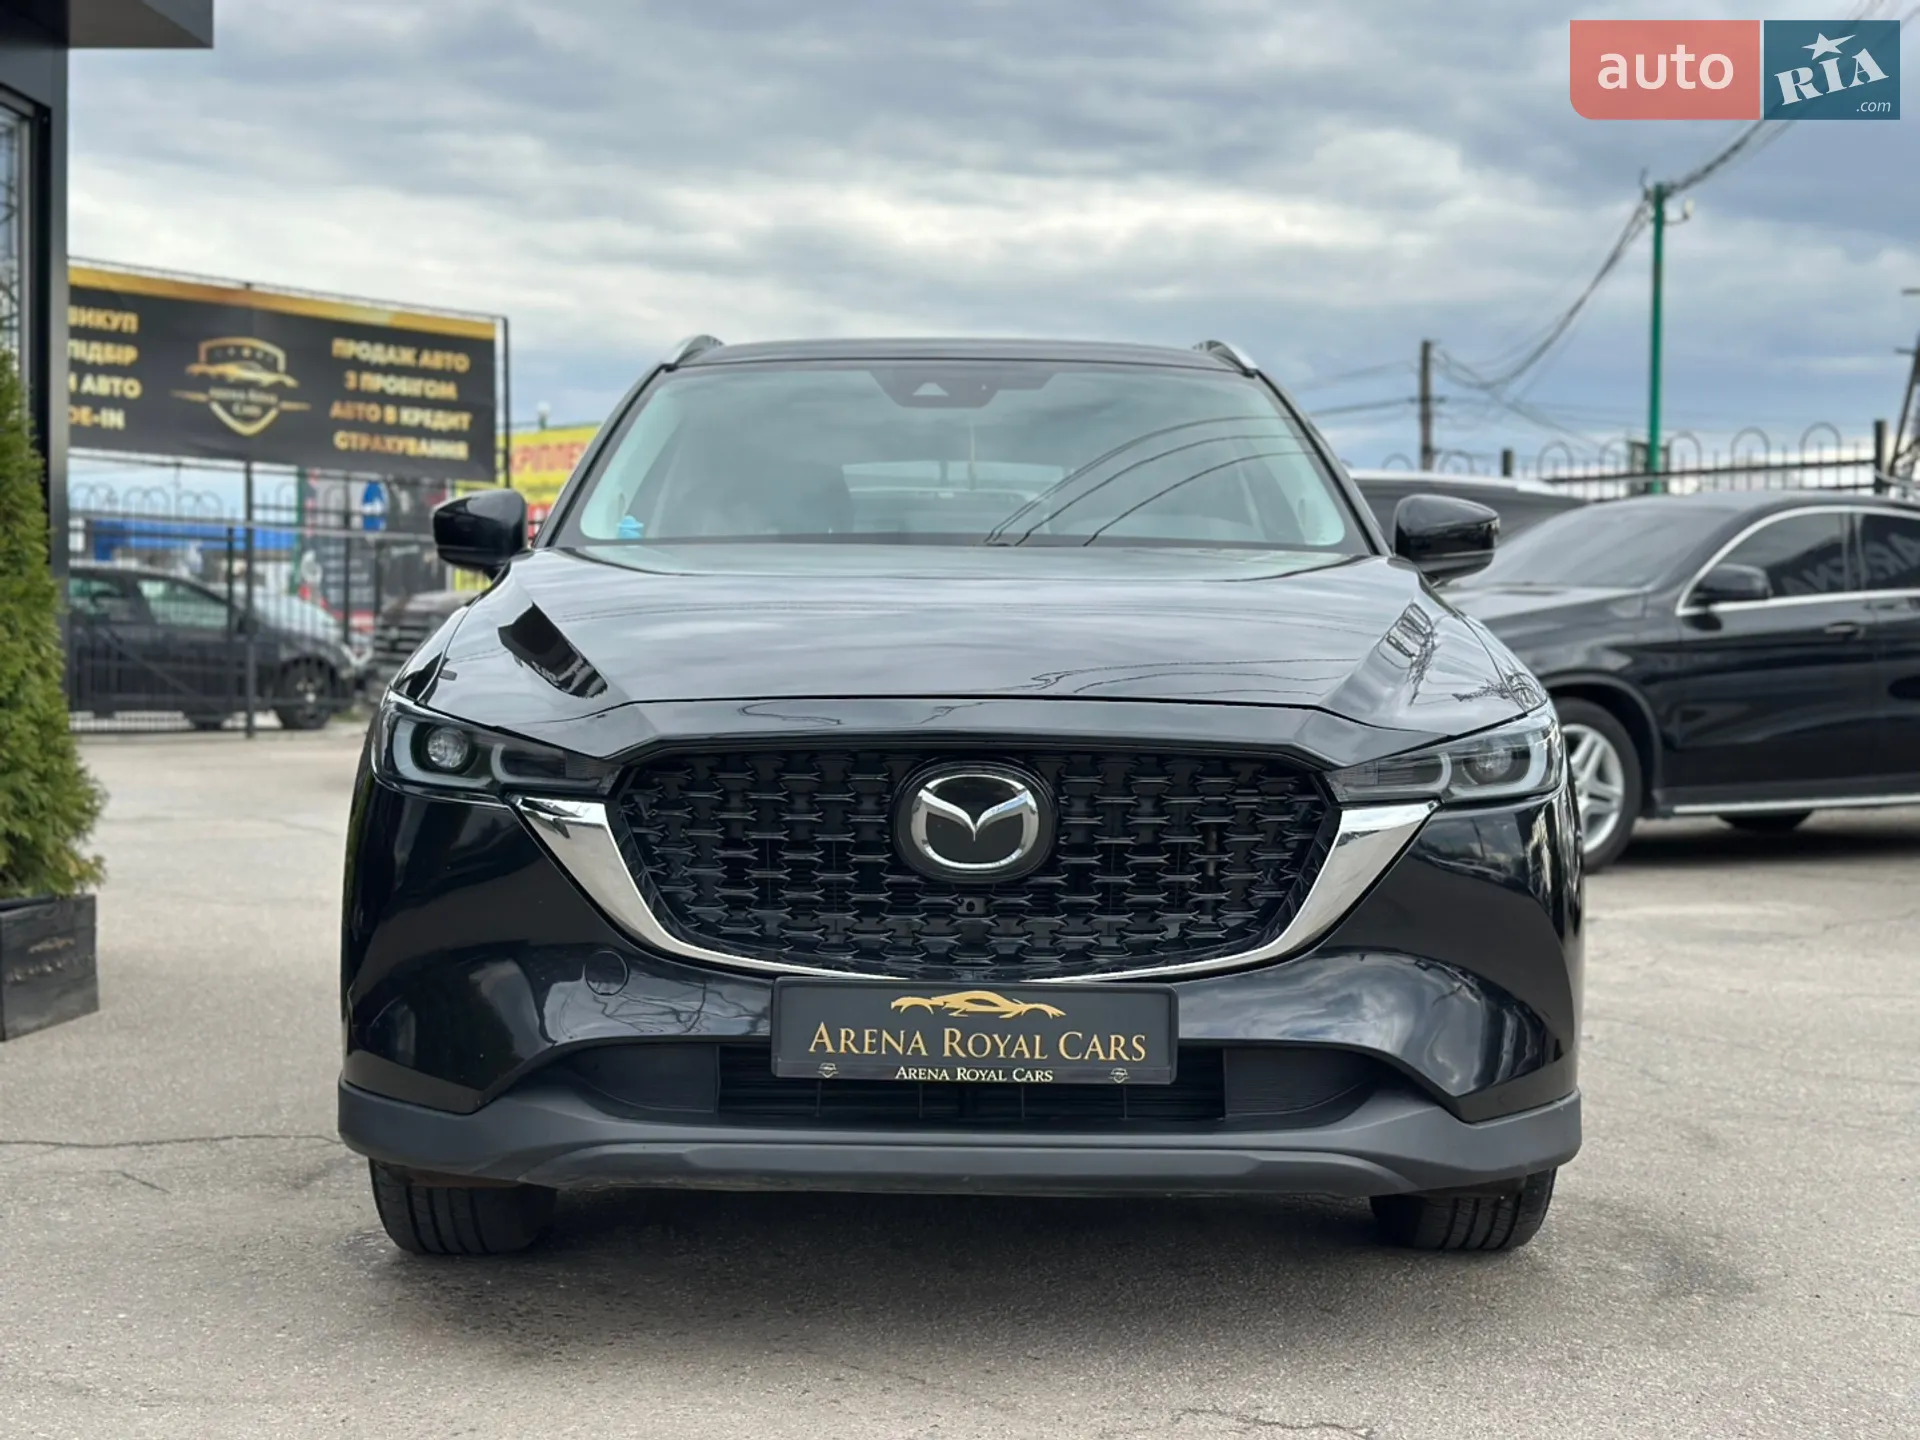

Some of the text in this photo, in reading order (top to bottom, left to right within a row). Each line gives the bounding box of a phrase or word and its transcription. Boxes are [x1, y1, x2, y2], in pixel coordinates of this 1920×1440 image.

[331, 337, 471, 374] ПРОДАЖ АВТО
[359, 371, 459, 401] ПРОБІГОМ
[329, 399, 473, 432] АВТО В КРЕДИТ
[333, 430, 470, 461] СТРАХУВАННЯ
[808, 1021, 1146, 1062] ARENA ROYAL CARS
[895, 1066, 1054, 1083] ARENA ROYAL CARS
